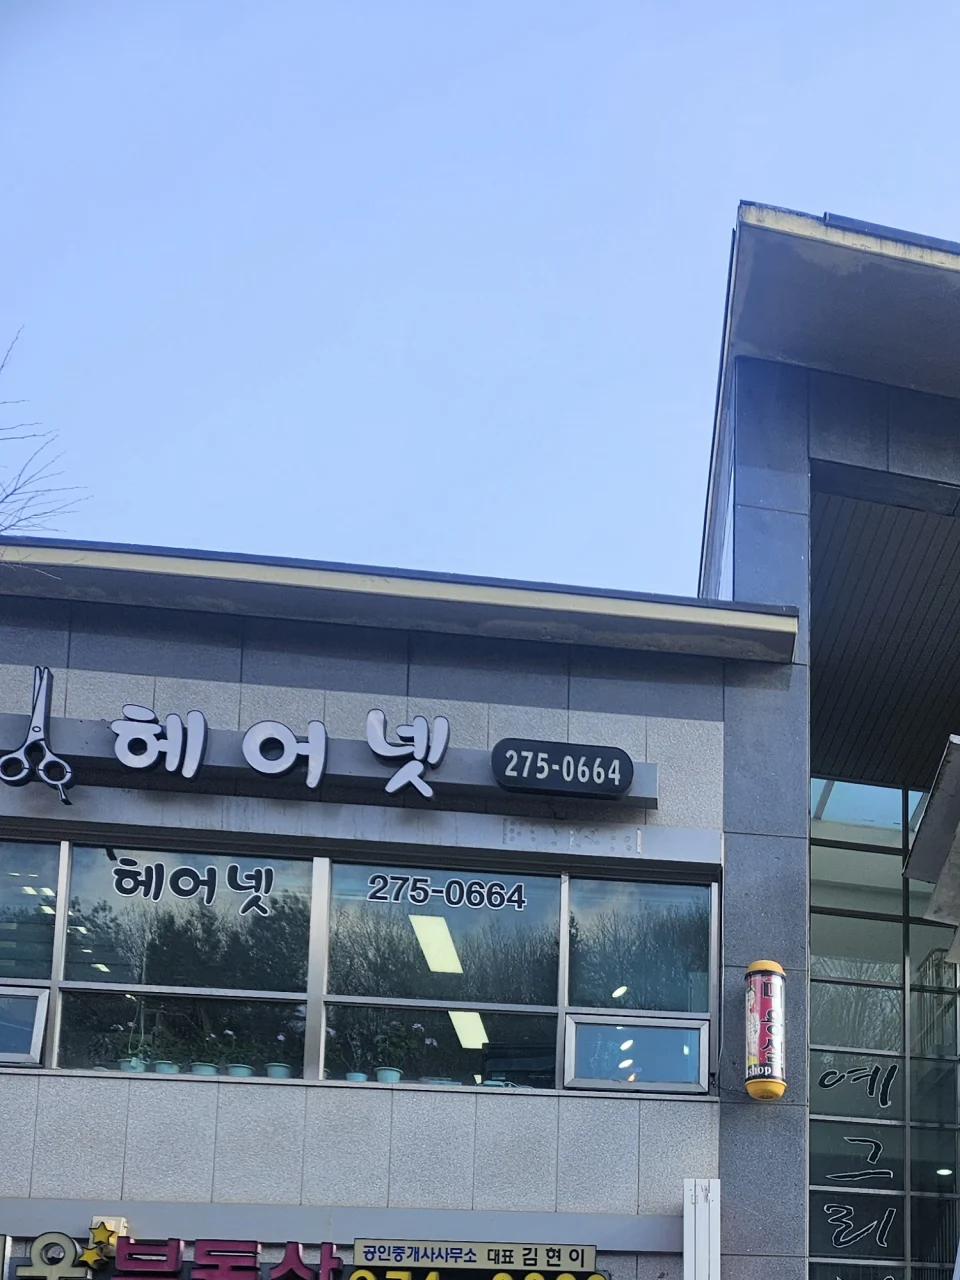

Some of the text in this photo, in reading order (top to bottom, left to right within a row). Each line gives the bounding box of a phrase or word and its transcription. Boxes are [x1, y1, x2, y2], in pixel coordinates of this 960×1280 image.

[111, 704, 449, 798] 헤어넷
[505, 750, 620, 785] 275-0664
[112, 857, 274, 916] 헤어넷
[367, 873, 527, 911] 275-0664
[363, 1245, 477, 1264] 공인중개사사무소
[487, 1248, 515, 1265] 대표
